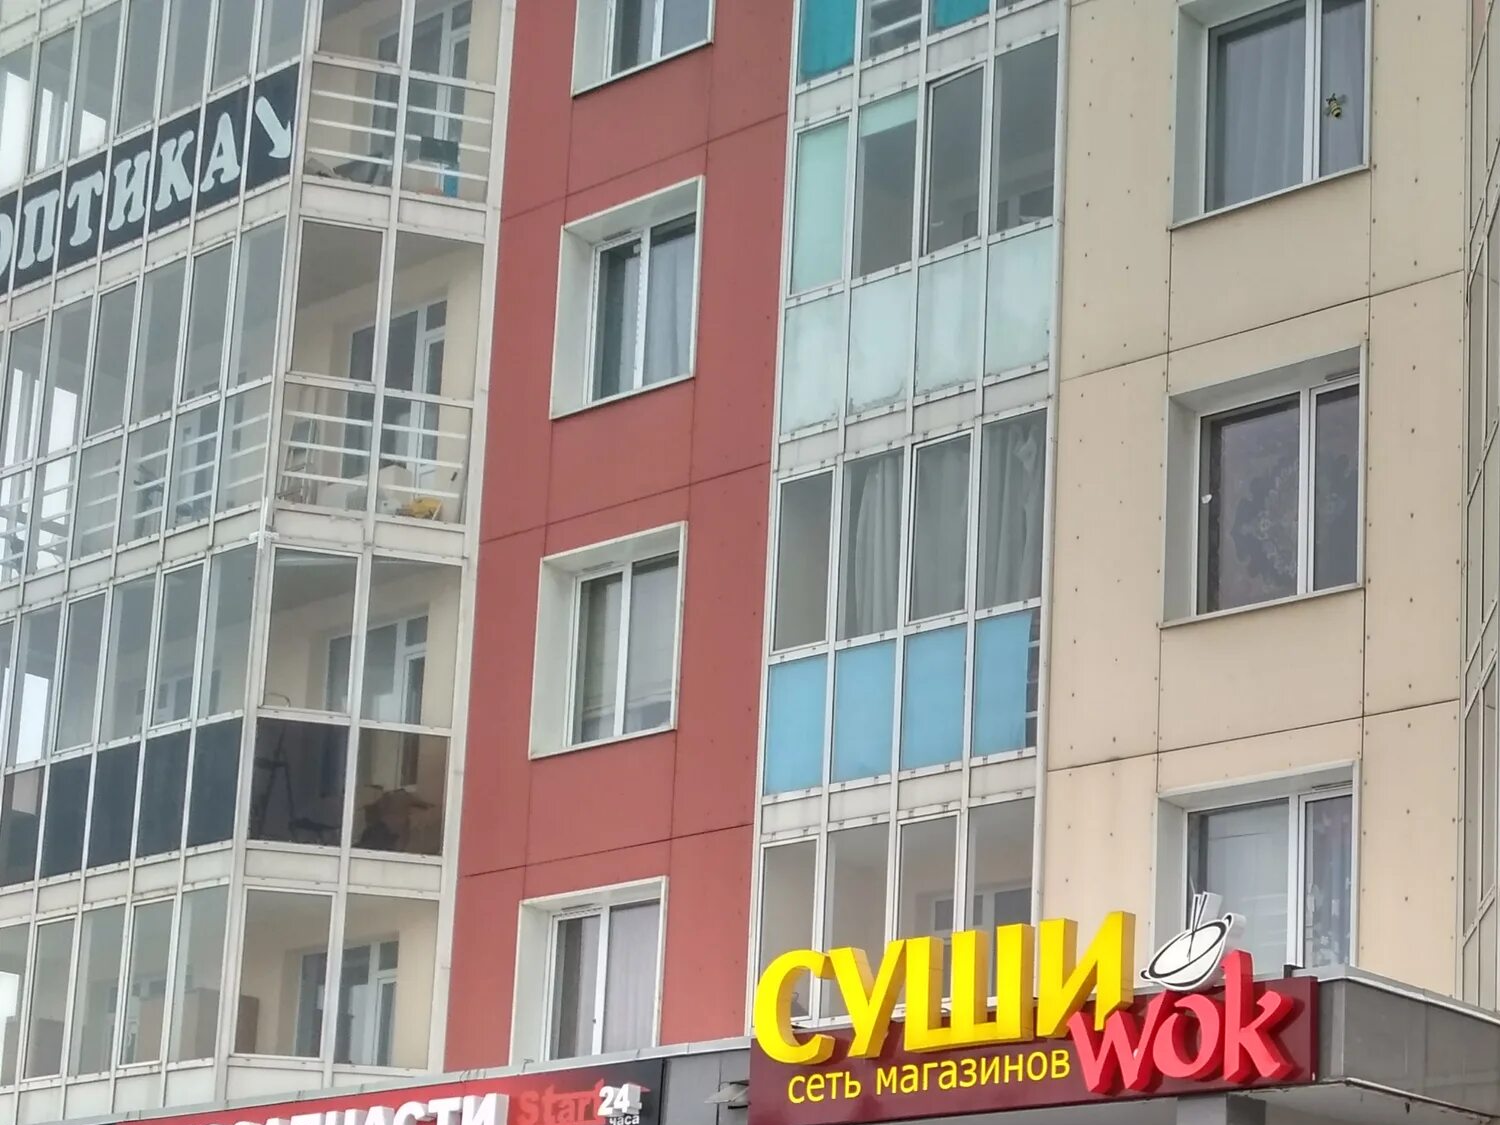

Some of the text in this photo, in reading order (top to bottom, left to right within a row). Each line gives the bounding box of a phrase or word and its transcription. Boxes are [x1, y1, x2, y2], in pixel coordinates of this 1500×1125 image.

[754, 911, 1134, 1065] СУШИ
[598, 1083, 642, 1117] 24
[787, 1048, 1071, 1104] сеть магазинов
